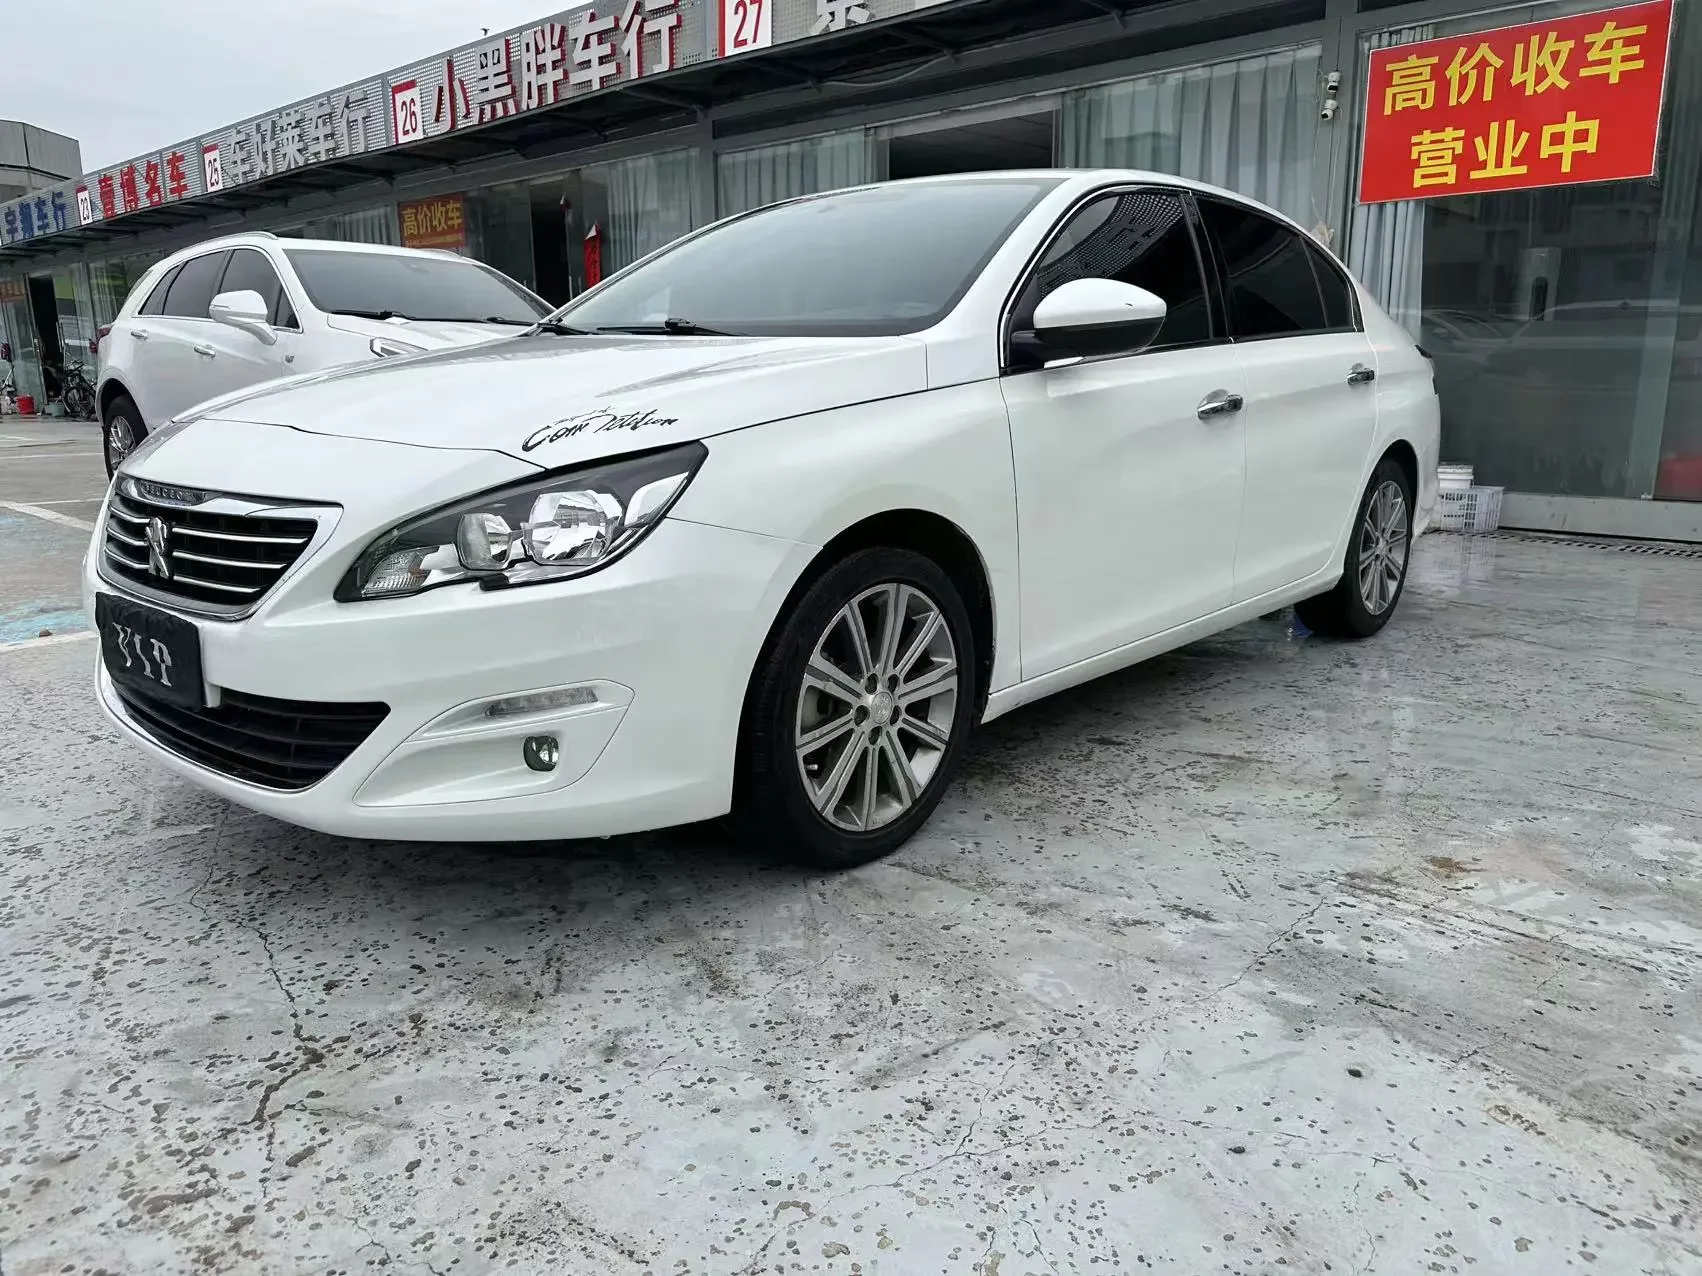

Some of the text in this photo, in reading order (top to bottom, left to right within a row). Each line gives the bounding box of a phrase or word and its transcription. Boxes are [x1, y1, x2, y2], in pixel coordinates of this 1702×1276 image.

[733, 0, 763, 48] 27
[430, 0, 683, 133] 小黑胖车行
[1383, 21, 1647, 116] 高价收车
[222, 89, 372, 184] 车好莱车行
[400, 96, 418, 136] 26
[207, 157, 220, 188] 25
[1410, 110, 1600, 188] 营业中
[80, 196, 90, 221] 23
[402, 200, 462, 237] 高价收车
[112, 621, 173, 688] VIP
